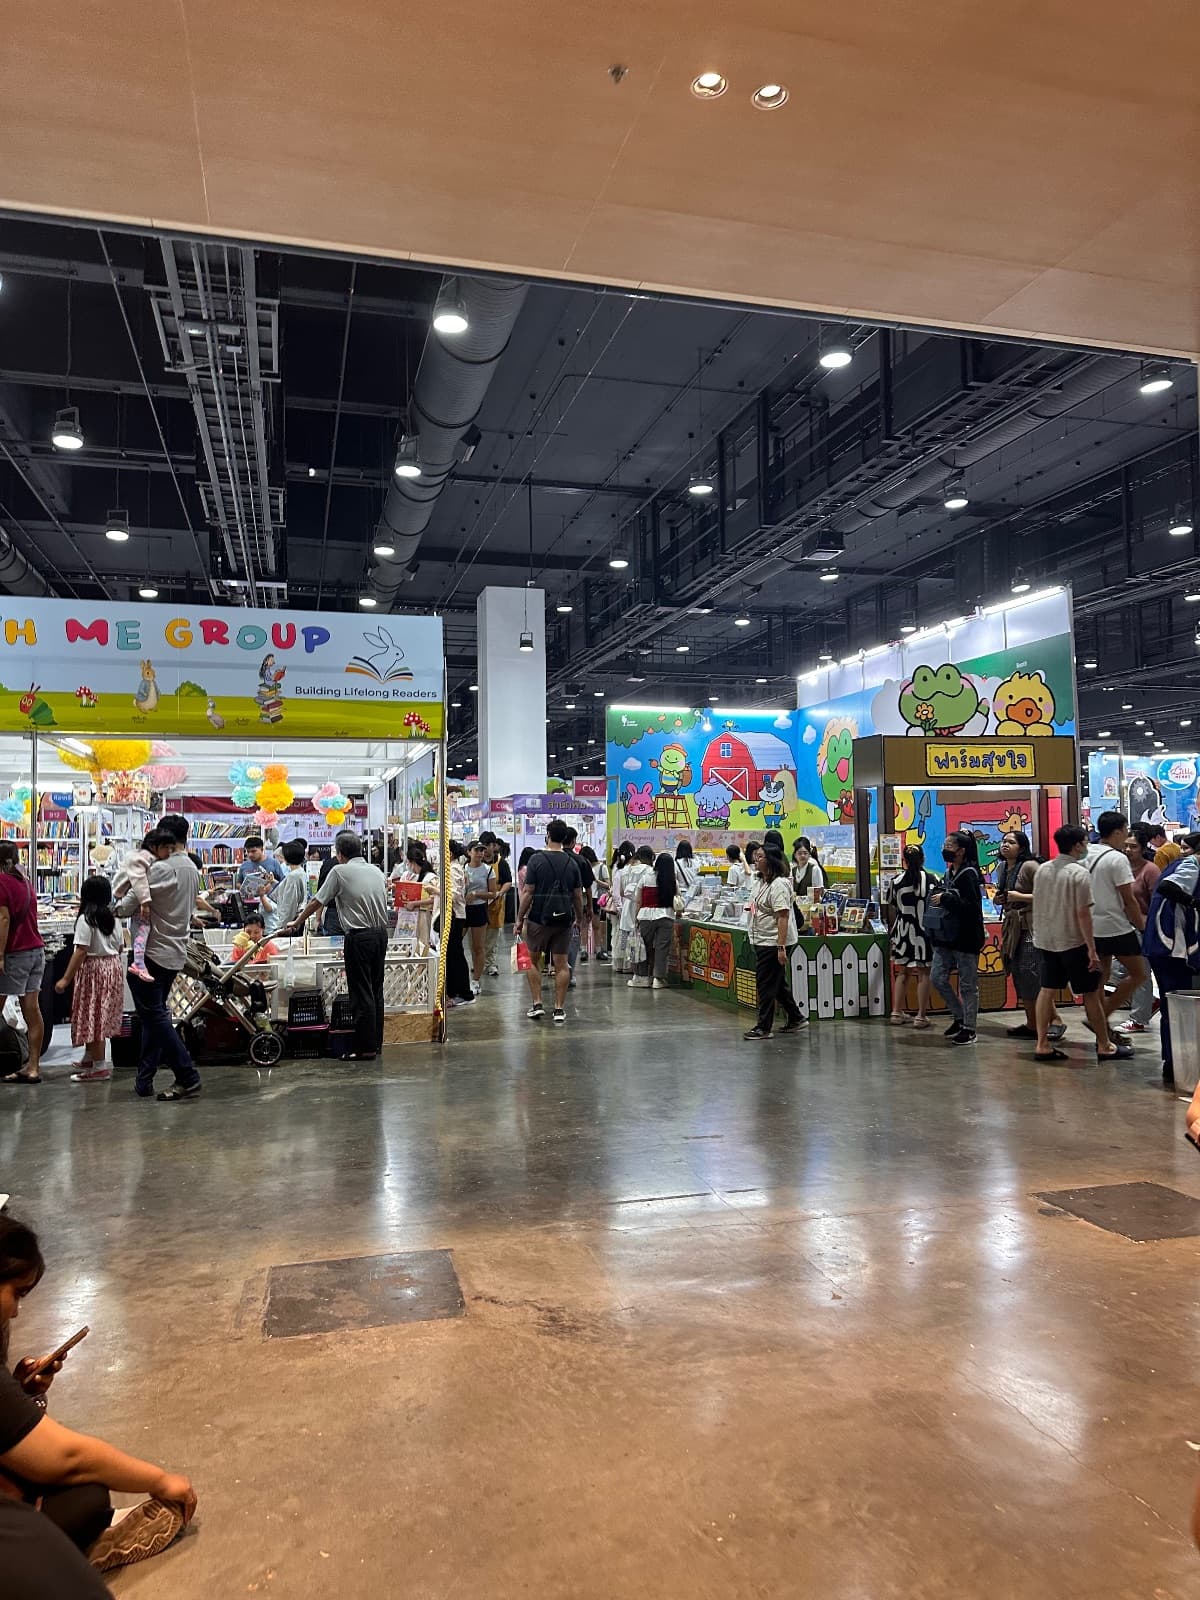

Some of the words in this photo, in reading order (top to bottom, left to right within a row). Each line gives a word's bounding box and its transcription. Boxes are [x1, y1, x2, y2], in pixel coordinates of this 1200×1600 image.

[0, 616, 37, 647] H
[65, 618, 142, 652] ME
[164, 618, 331, 654] GROUP
[295, 686, 341, 697] Building
[344, 687, 389, 699] Lifelong
[392, 689, 438, 699] Readers
[934, 749, 1027, 773] ฟาร์มสุขใจ
[582, 784, 600, 793] C06
